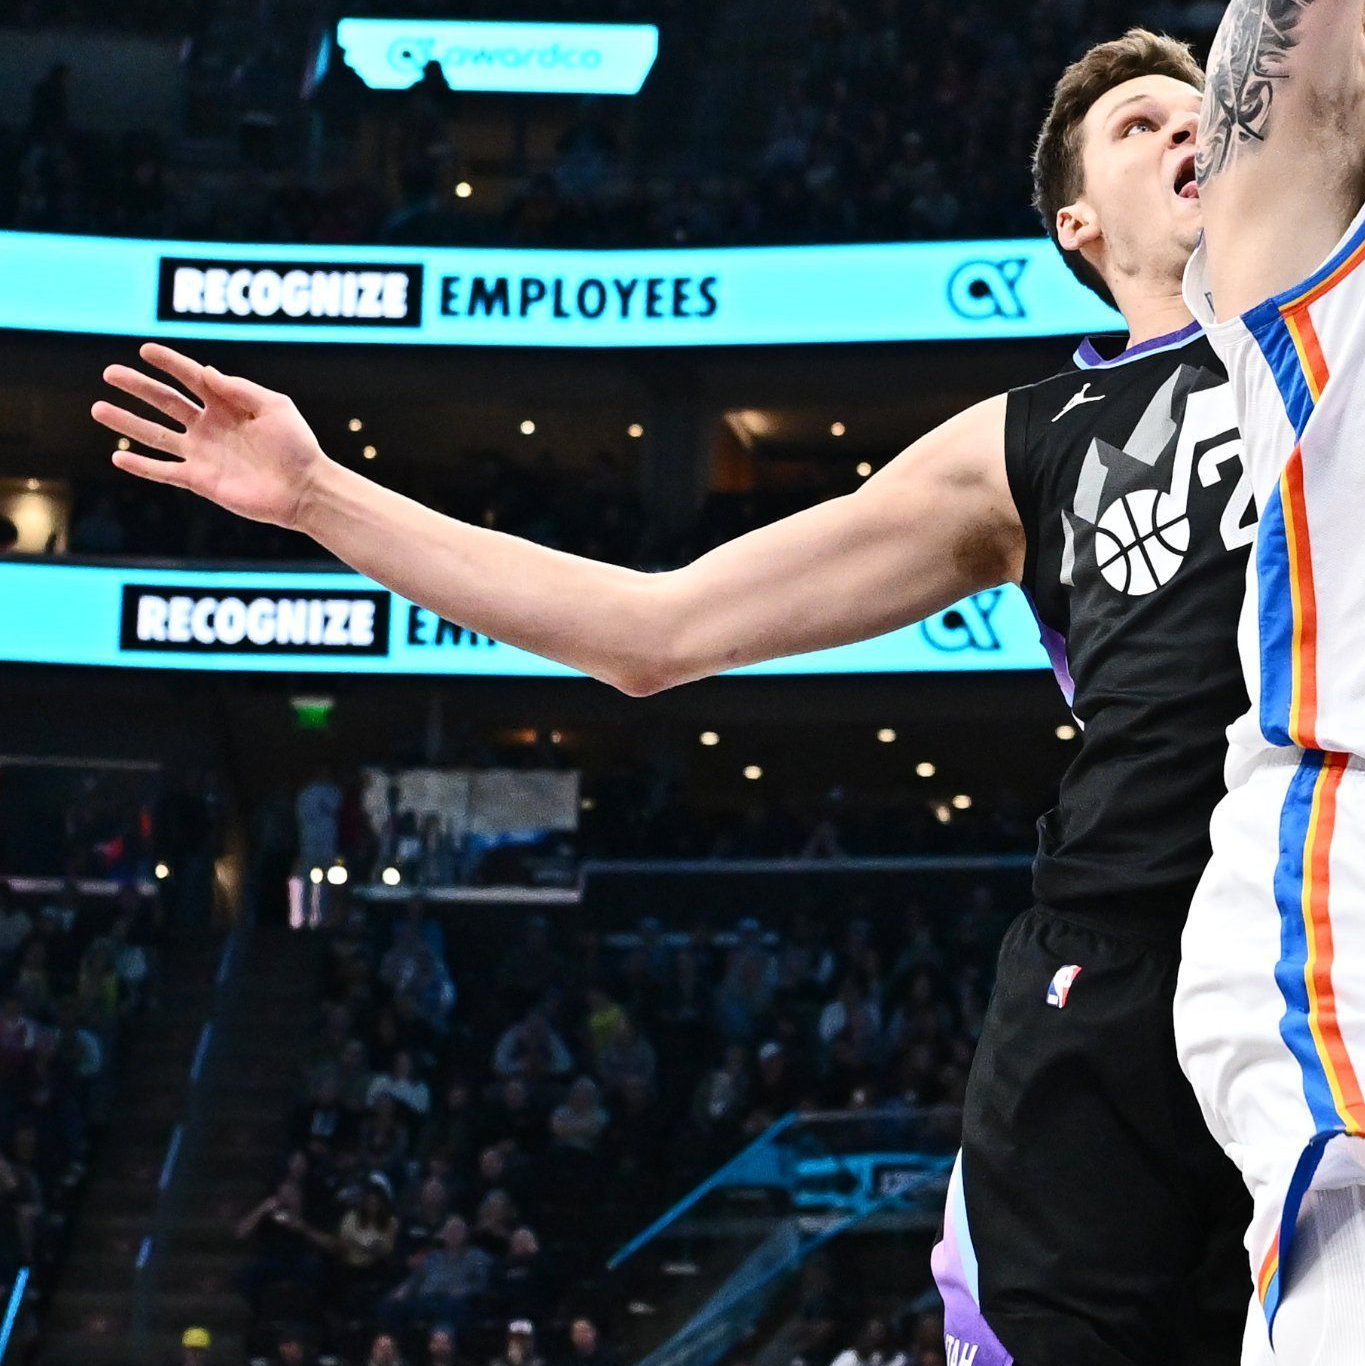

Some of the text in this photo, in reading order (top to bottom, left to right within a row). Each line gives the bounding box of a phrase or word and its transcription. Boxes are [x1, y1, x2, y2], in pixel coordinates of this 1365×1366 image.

[173, 266, 719, 319] RECOGNIZE EMPLOYEES
[136, 594, 376, 647] RECOGNIZE
